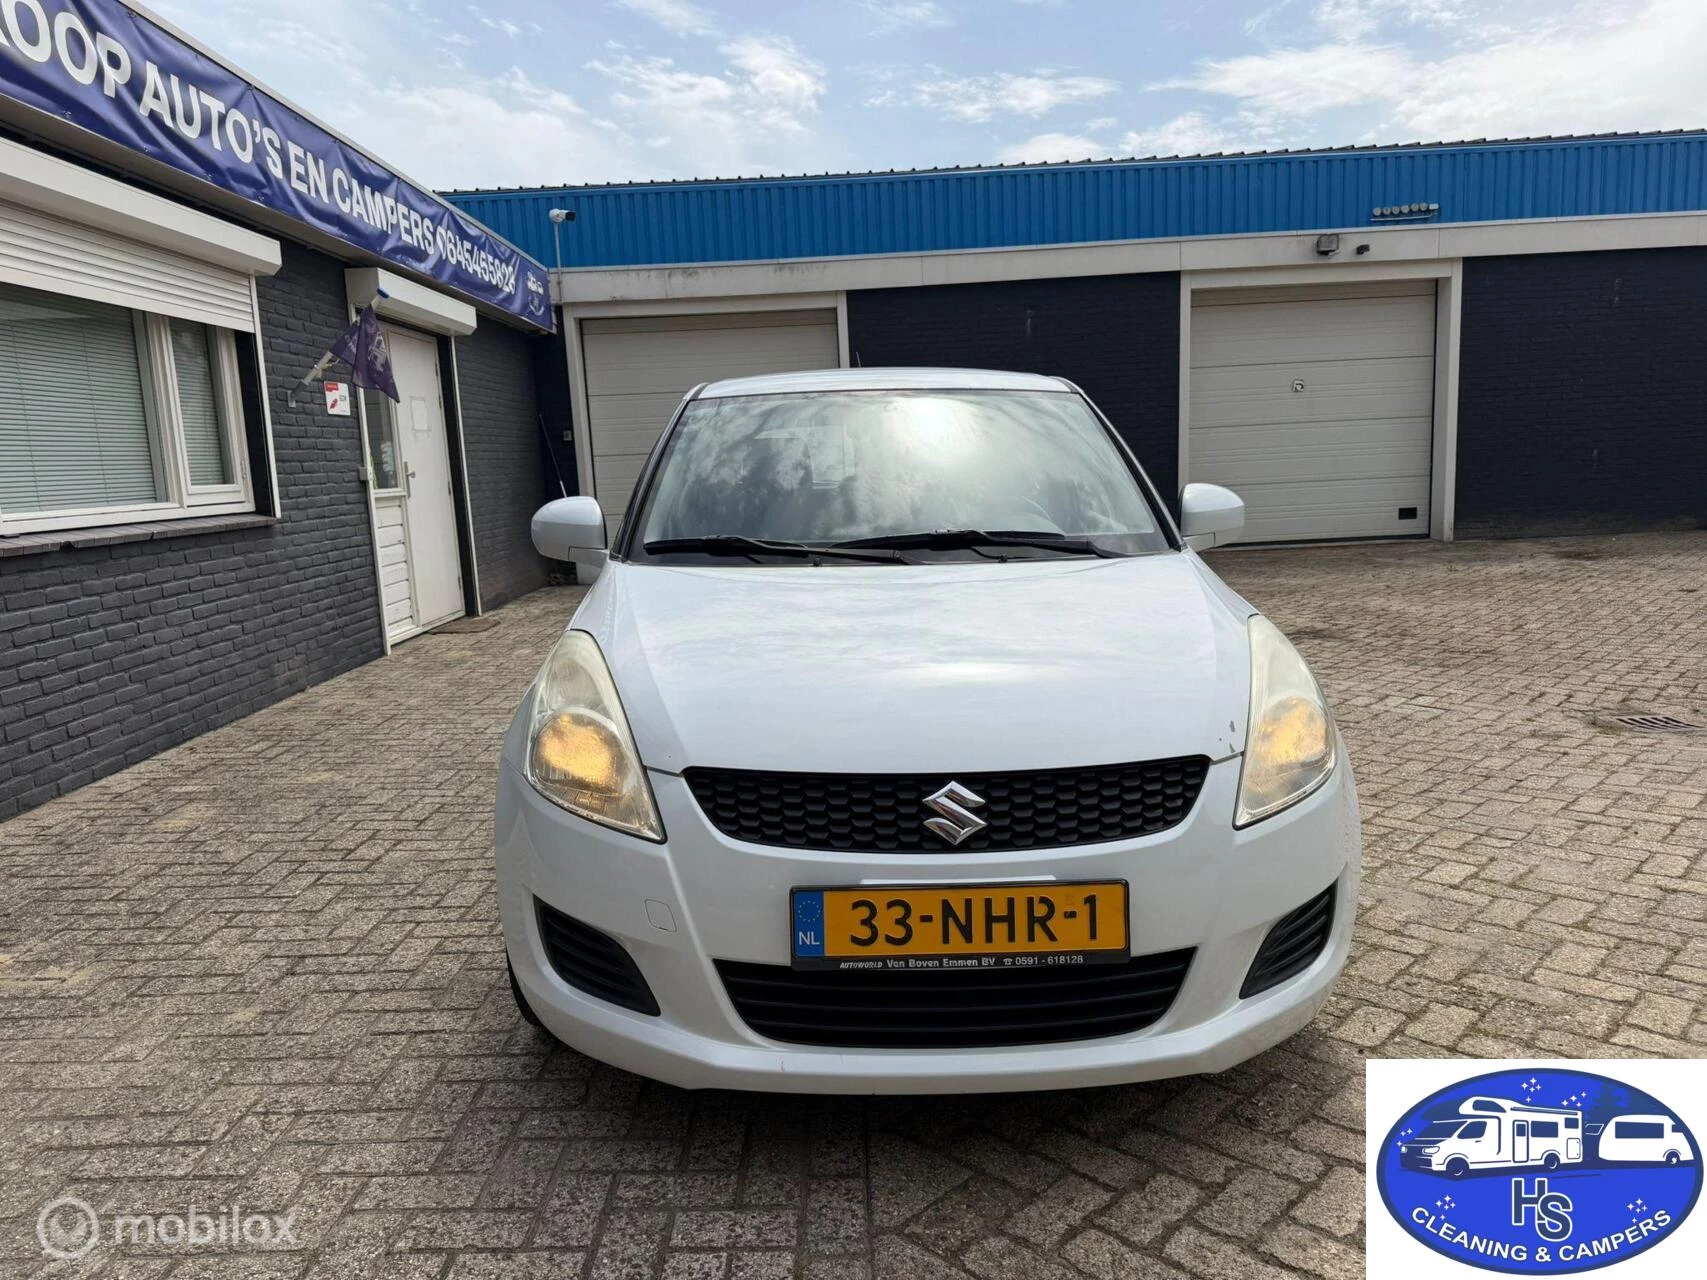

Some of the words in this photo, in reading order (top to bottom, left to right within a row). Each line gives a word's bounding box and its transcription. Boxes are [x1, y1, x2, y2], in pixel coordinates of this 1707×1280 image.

[0, 0, 132, 98] OOP
[139, 61, 284, 180] AUTO'S
[287, 140, 330, 204] EN
[332, 167, 435, 255] CAMPERS
[849, 894, 1099, 947] 33-NHR-1
[798, 931, 820, 946] NL
[839, 961, 883, 969] AUTOWORLD
[886, 959, 905, 968] Van
[908, 959, 940, 968] Boven
[942, 958, 978, 967] Emmen
[981, 957, 996, 966] BV
[1015, 956, 1039, 965] 0591
[1047, 955, 1084, 965] 618128
